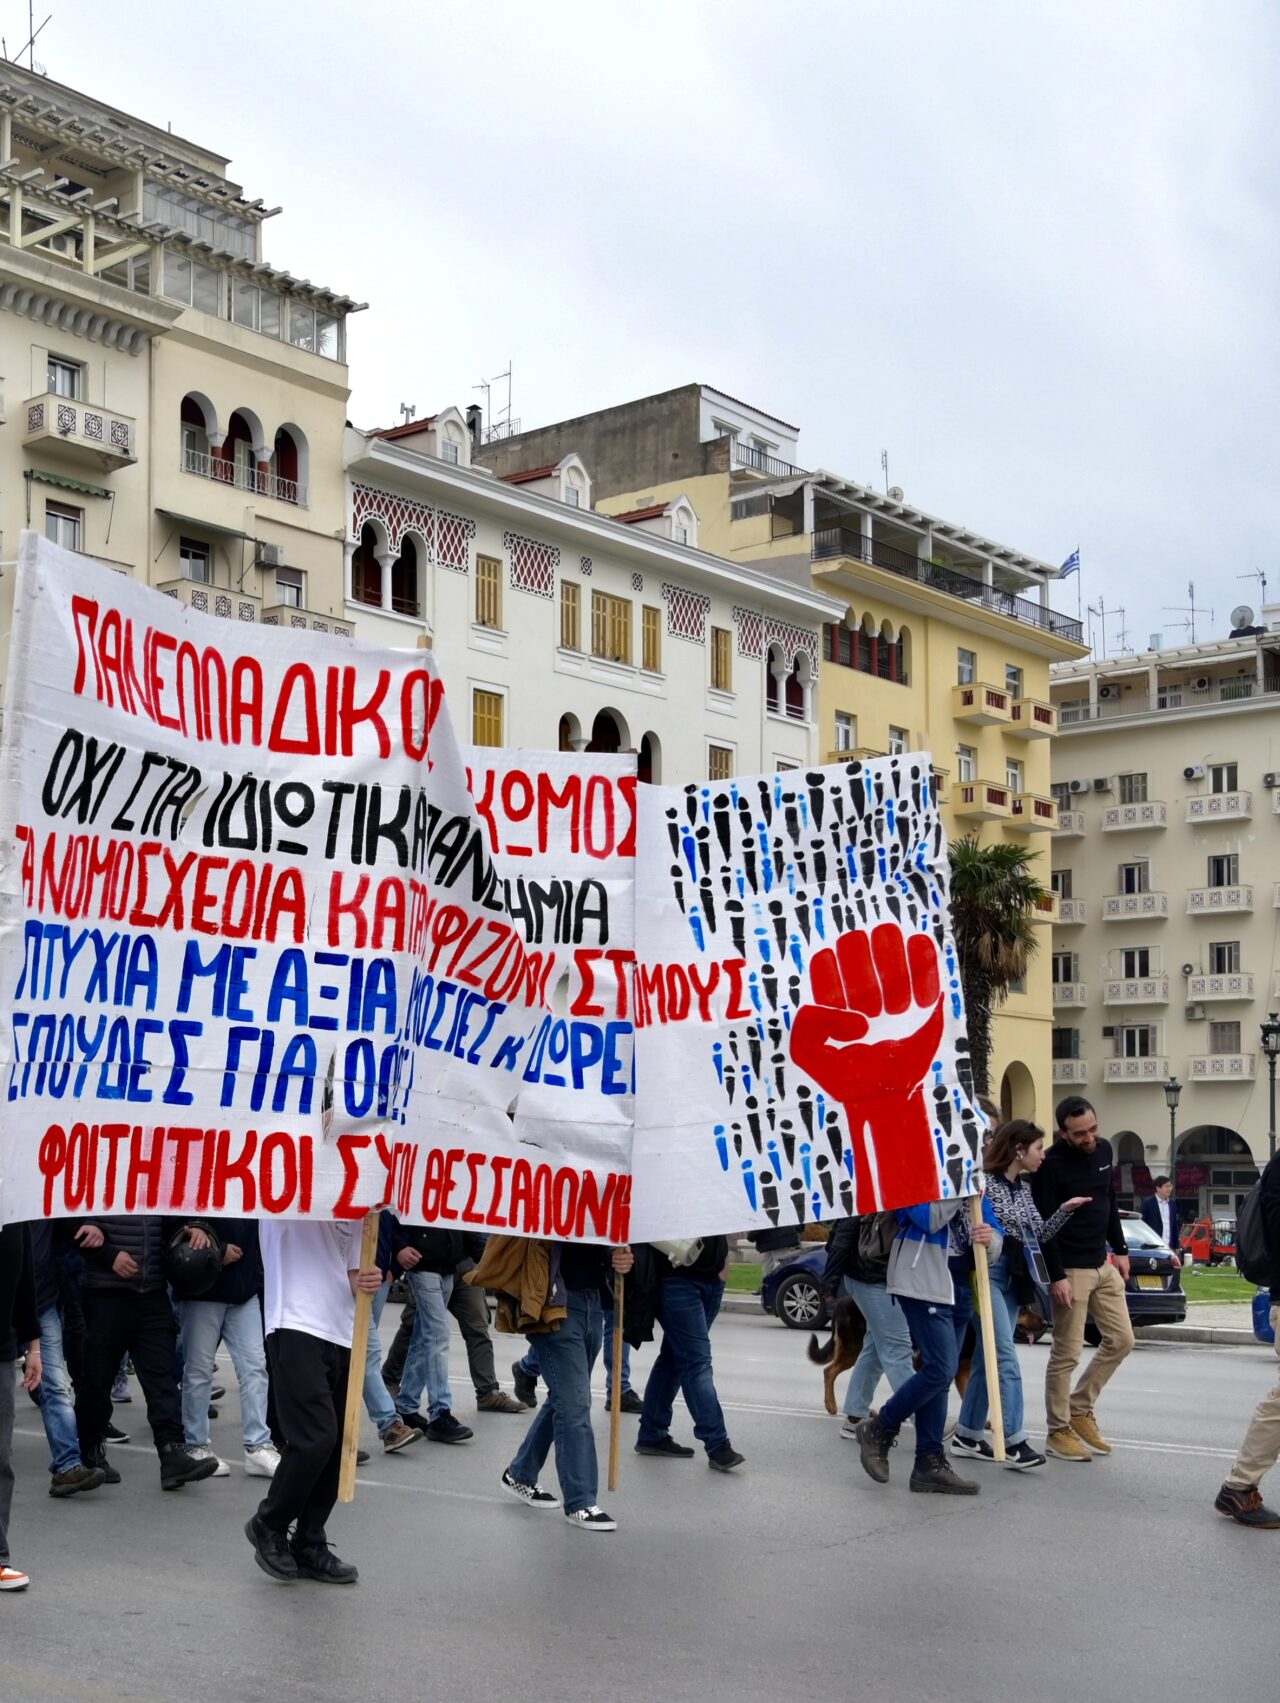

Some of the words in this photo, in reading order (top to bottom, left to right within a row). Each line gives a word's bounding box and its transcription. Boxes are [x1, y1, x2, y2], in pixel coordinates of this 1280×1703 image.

[42, 728, 126, 824] ΟΧΙ
[111, 751, 202, 841] ΣΤΑ
[38, 831, 306, 943] ΝΟΜΟΣΧΕΔΙΑ
[7, 1012, 204, 1106] ΣΠΟΥΔΕΣ
[220, 1026, 317, 1114] ΓΙΑ
[14, 919, 159, 1012] ΠΤΥΧΙΑ
[176, 939, 257, 1022] ΜΕ
[523, 1014, 636, 1095] ΔΩΡΕ
[38, 1122, 313, 1217] ΦΟΙΤΗΤΙΚΟΙ
